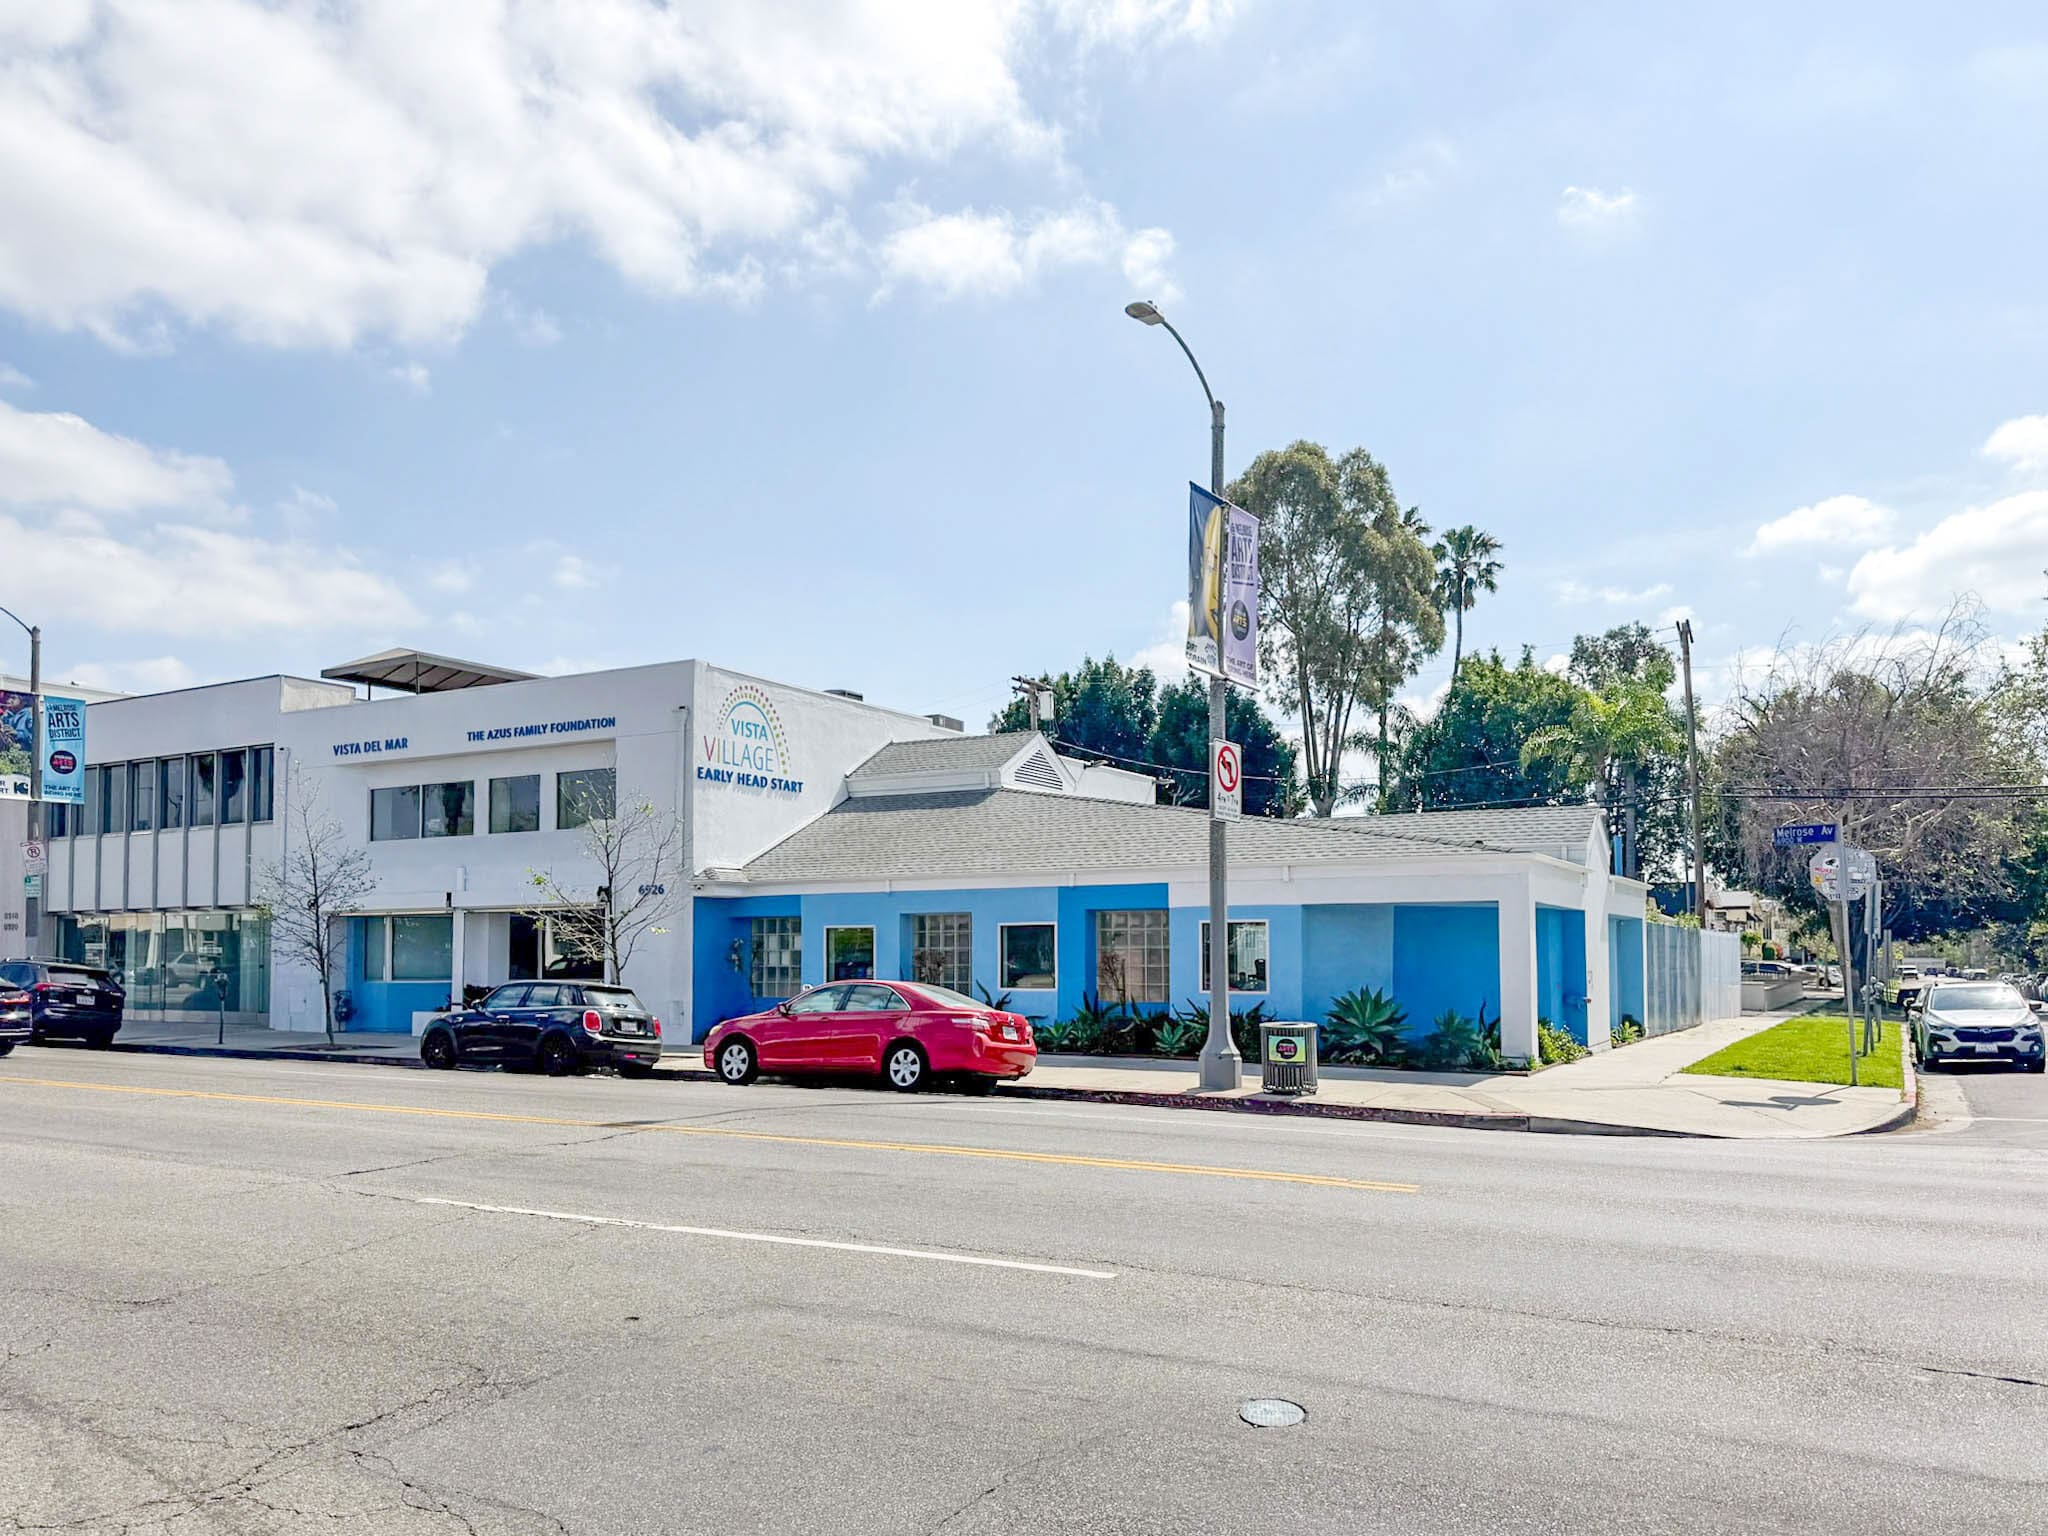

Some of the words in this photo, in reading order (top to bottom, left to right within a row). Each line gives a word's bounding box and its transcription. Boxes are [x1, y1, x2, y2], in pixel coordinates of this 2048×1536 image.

[48, 712, 80, 728] ARTS
[467, 730, 485, 742] THE
[487, 727, 512, 740] AZUS
[514, 724, 549, 738] FAMILY
[550, 717, 616, 733] FOUNDATION
[731, 718, 768, 741] VISTA
[48, 728, 81, 738] DISTRICT
[333, 742, 361, 756] VISTA
[364, 740, 382, 753] DEL
[384, 737, 409, 751] MAR
[703, 735, 774, 772] VILLAGE
[697, 766, 734, 783] EARLY
[737, 773, 768, 788] HEAD
[771, 778, 804, 793] START
[1776, 827, 1814, 838] Melrose
[1821, 826, 1833, 836] Av
